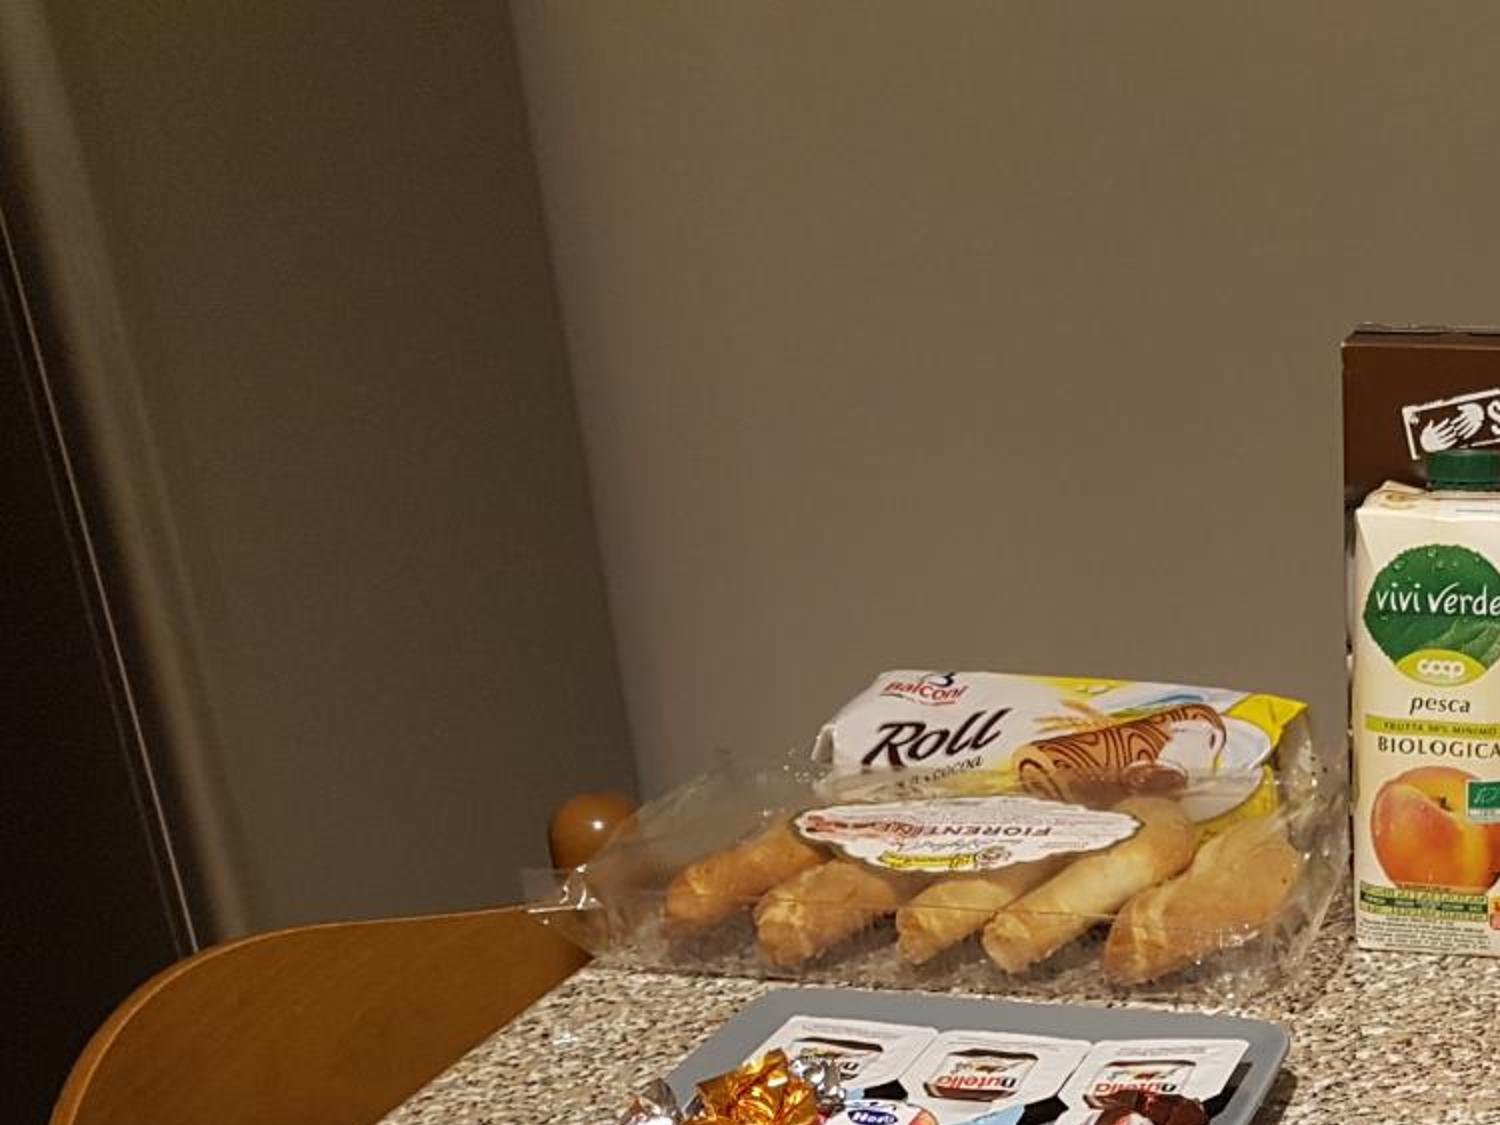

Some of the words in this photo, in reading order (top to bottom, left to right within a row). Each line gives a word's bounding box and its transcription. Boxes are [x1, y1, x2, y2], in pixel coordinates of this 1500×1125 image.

[1376, 582, 1421, 612] vivi
[1409, 696, 1471, 715] pesca
[1383, 721, 1424, 733] FRUTTA
[861, 707, 1012, 772] Roll
[937, 1074, 1017, 1090] nutella
